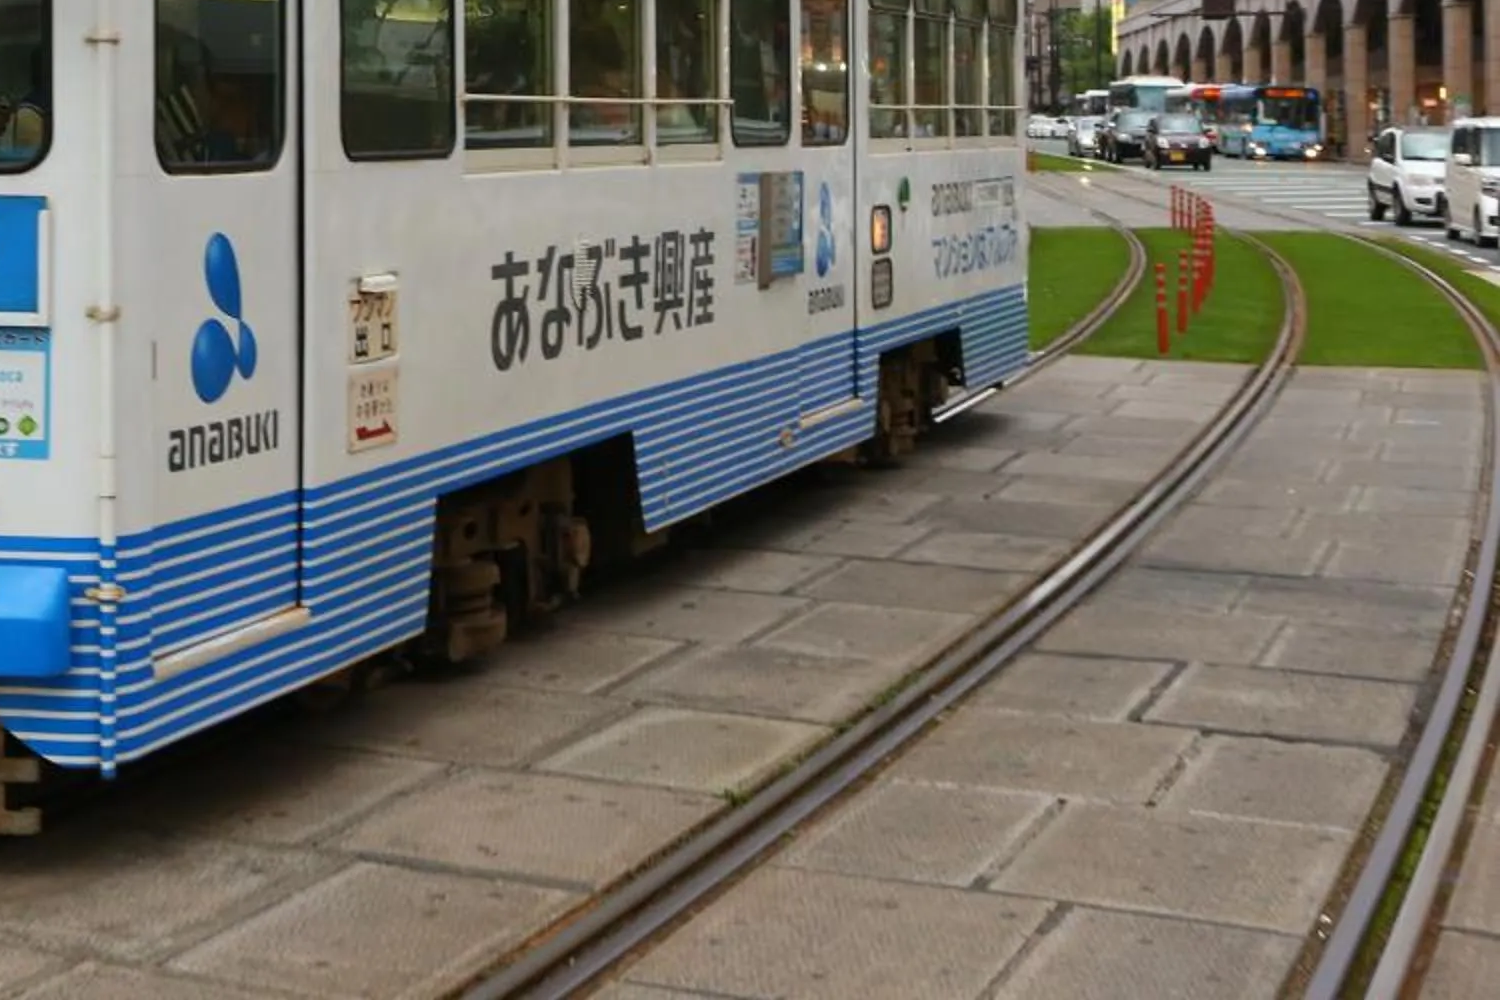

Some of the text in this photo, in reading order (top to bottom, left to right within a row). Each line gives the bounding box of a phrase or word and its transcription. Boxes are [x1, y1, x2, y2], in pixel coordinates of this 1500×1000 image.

[491, 227, 715, 372] あなぶき興産
